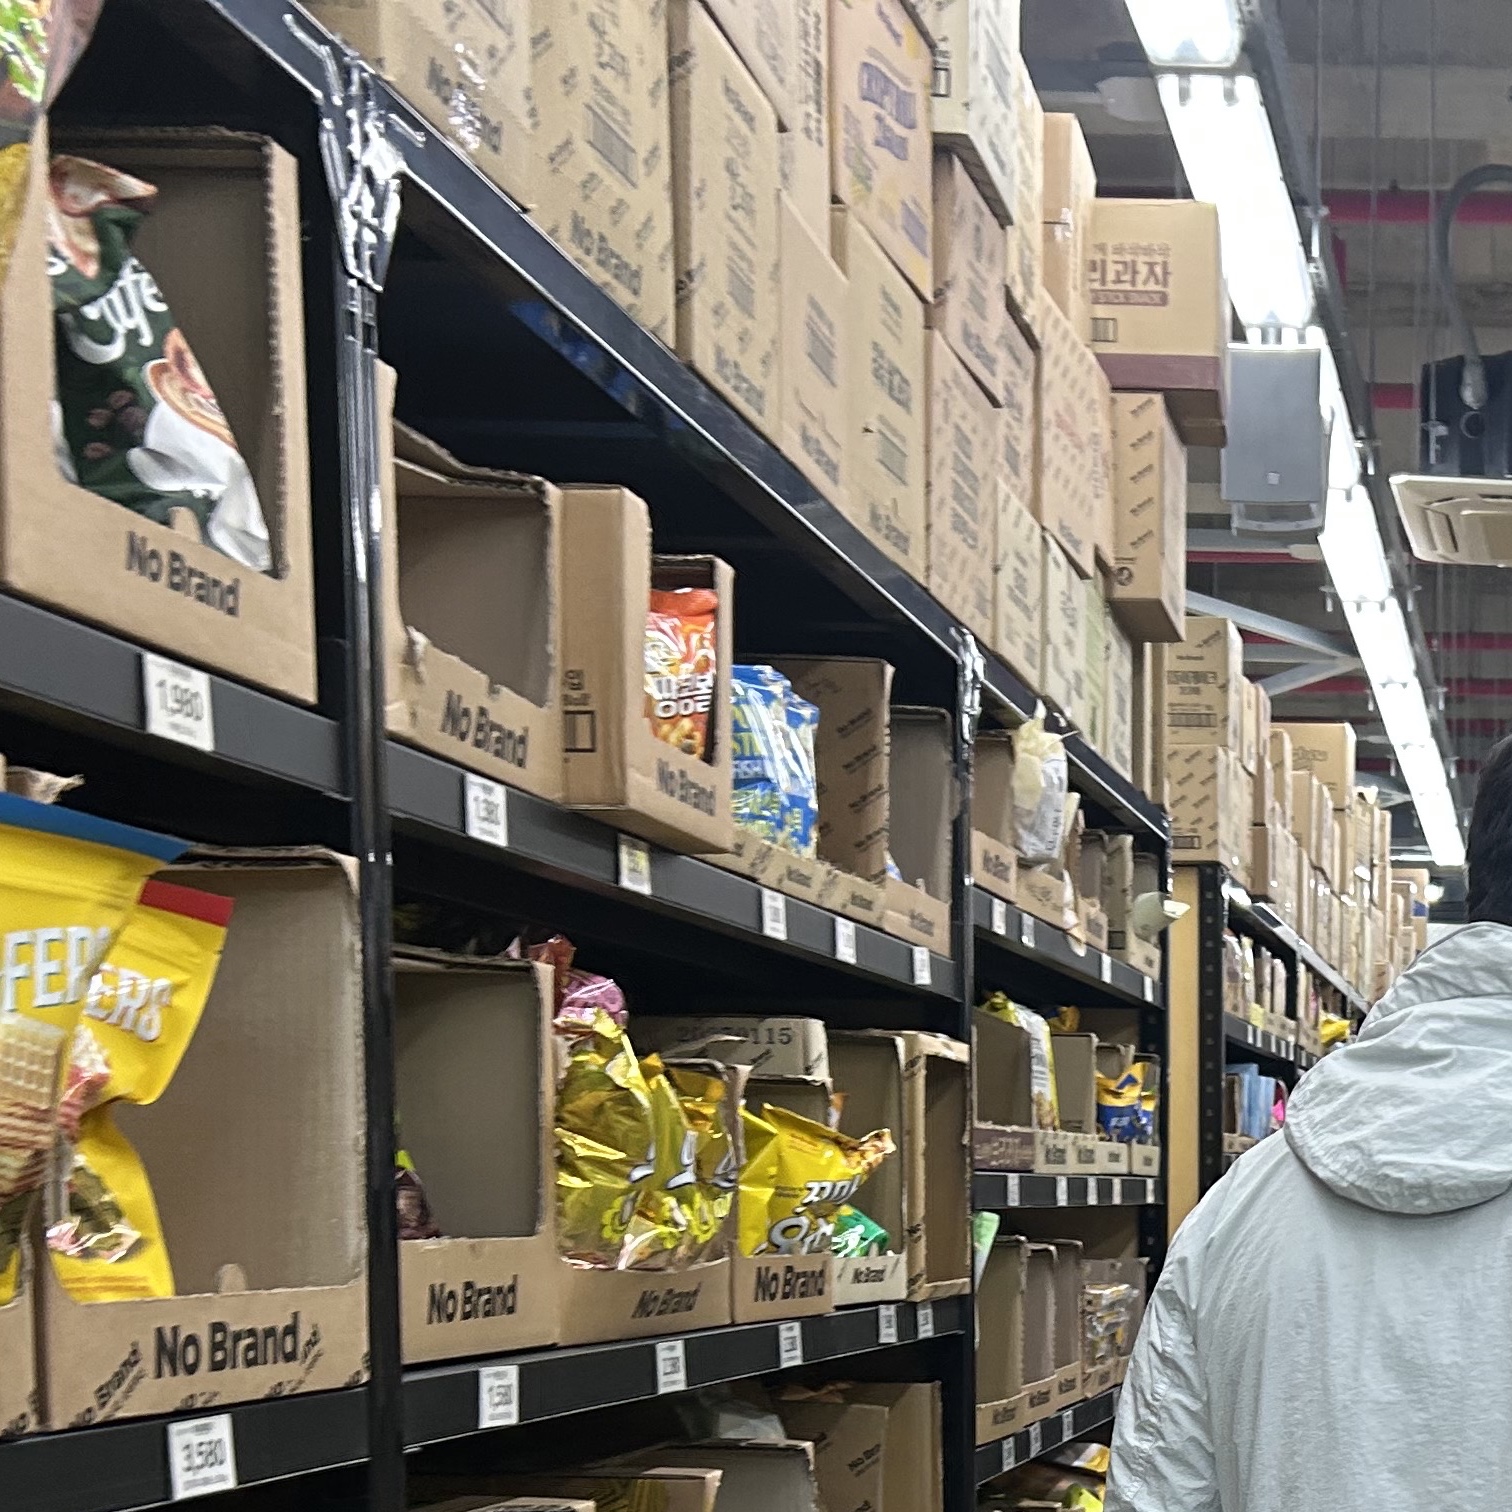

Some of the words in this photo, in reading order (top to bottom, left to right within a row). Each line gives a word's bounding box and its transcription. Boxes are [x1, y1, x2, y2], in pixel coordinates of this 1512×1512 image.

[127, 530, 163, 583] No
[166, 550, 242, 619] Brand
[440, 689, 471, 743] No
[471, 704, 529, 769] Brand
[426, 1282, 459, 1326] No
[460, 1273, 519, 1322] Brand
[754, 1265, 779, 1303] No
[781, 1259, 826, 1302] Brand
[154, 1325, 203, 1380] No
[207, 1309, 301, 1374] Brand
